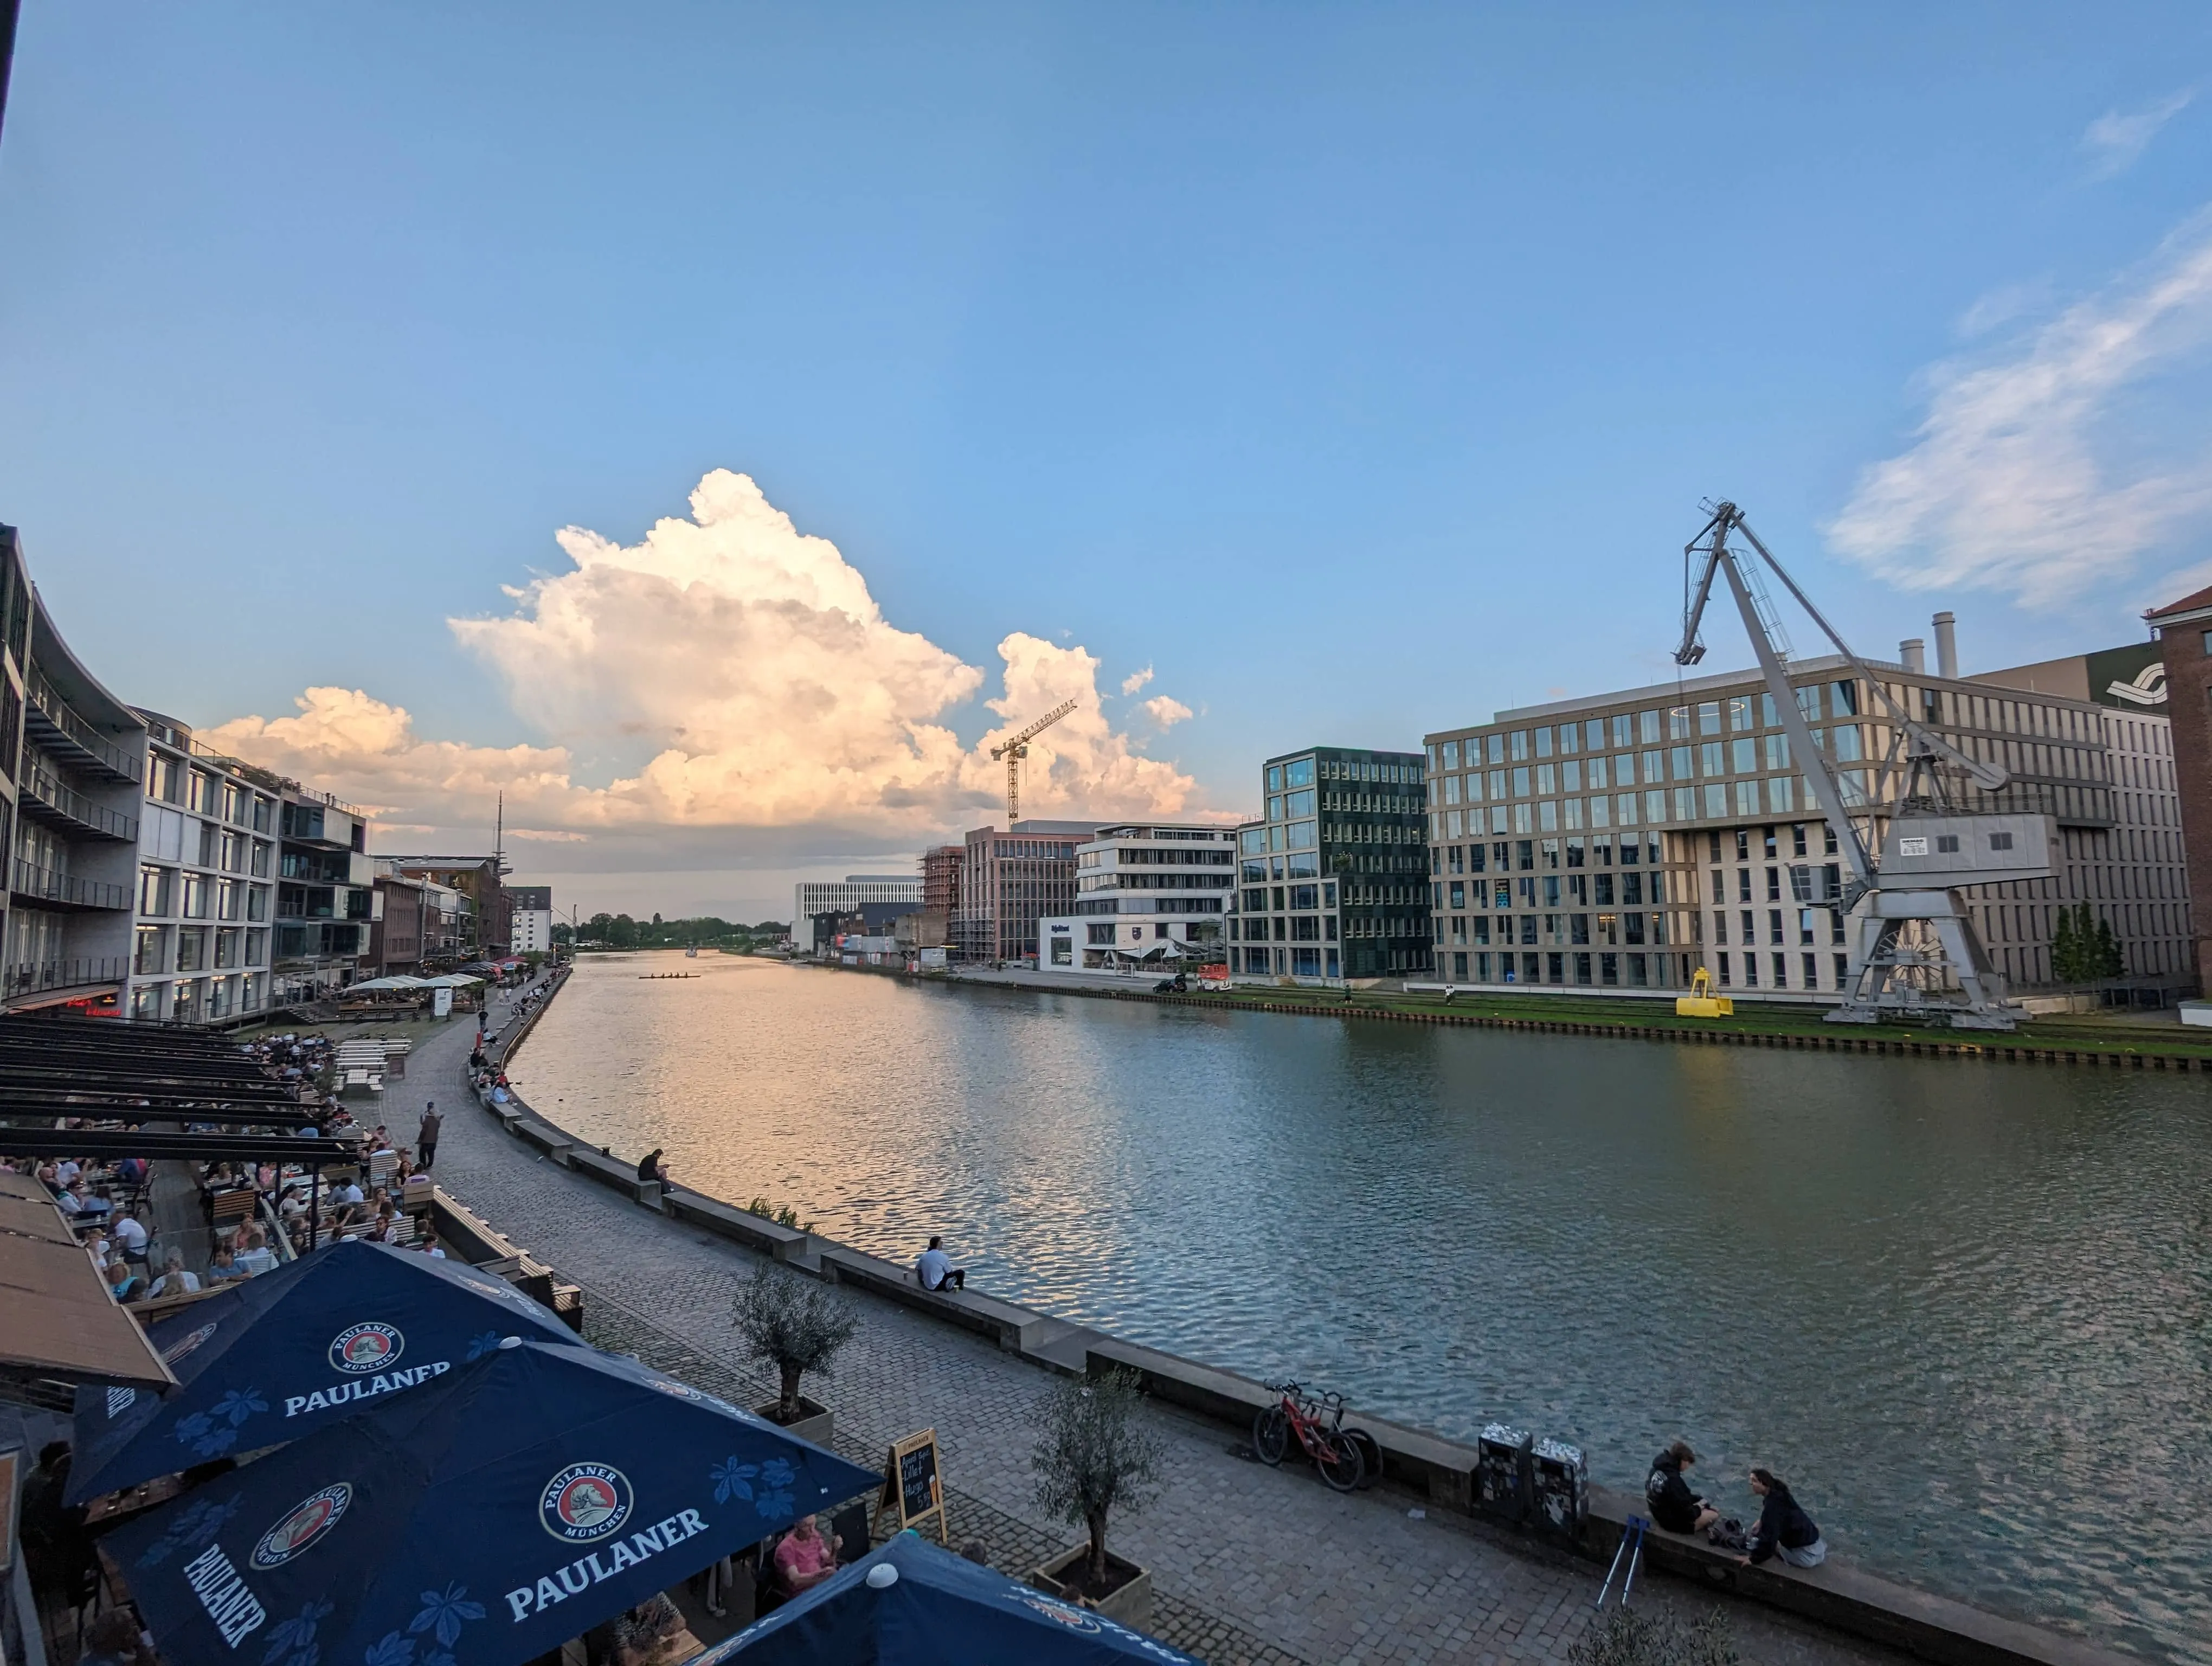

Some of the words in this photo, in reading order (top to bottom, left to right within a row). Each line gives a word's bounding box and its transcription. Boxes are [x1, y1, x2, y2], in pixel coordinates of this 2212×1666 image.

[334, 1325, 396, 1349] PAULANER
[342, 1353, 395, 1370] MÜNCHEN
[545, 1466, 616, 1509] PAULANER
[305, 1488, 348, 1527] PAULANER
[564, 1504, 626, 1538] MÜNCHEN
[505, 1508, 709, 1623] PAULANER
[183, 1543, 266, 1649] PAULANER
